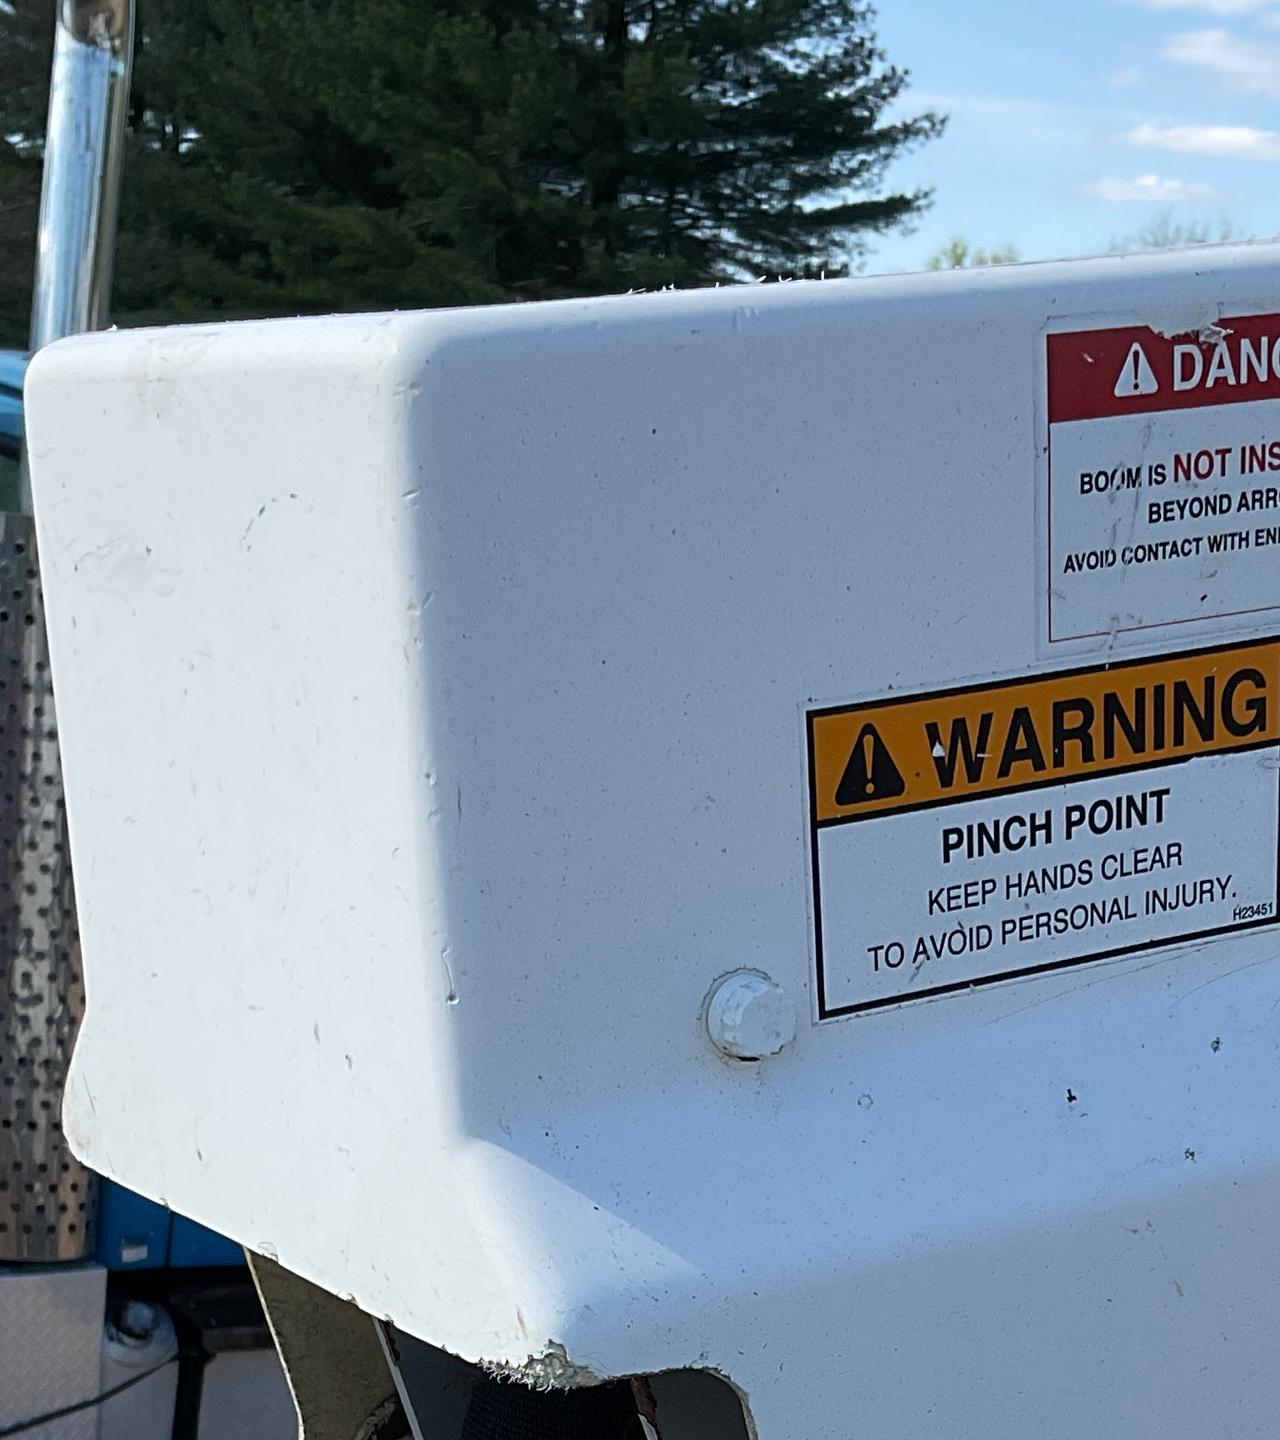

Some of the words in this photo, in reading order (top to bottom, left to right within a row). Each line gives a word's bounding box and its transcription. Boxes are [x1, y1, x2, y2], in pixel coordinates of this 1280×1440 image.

[1080, 465, 1142, 495] BOOM
[1147, 463, 1167, 487] IS
[1173, 447, 1232, 482] NOT
[1148, 492, 1232, 524] BEYOND
[1063, 547, 1117, 574] AVOID
[1121, 536, 1202, 566] CONTACT
[1207, 530, 1249, 554] WITH
[924, 667, 1269, 789] WARNING
[942, 810, 1052, 864] PINCH
[1065, 788, 1171, 841] POINT
[928, 878, 997, 916] KEEP
[1005, 859, 1093, 900] HANDS
[1101, 842, 1183, 880] CLEAR
[867, 943, 904, 972] TO
[912, 925, 993, 964] AVOID
[1001, 900, 1138, 945] PERSONAL
[1144, 875, 1238, 916] INJURY.
